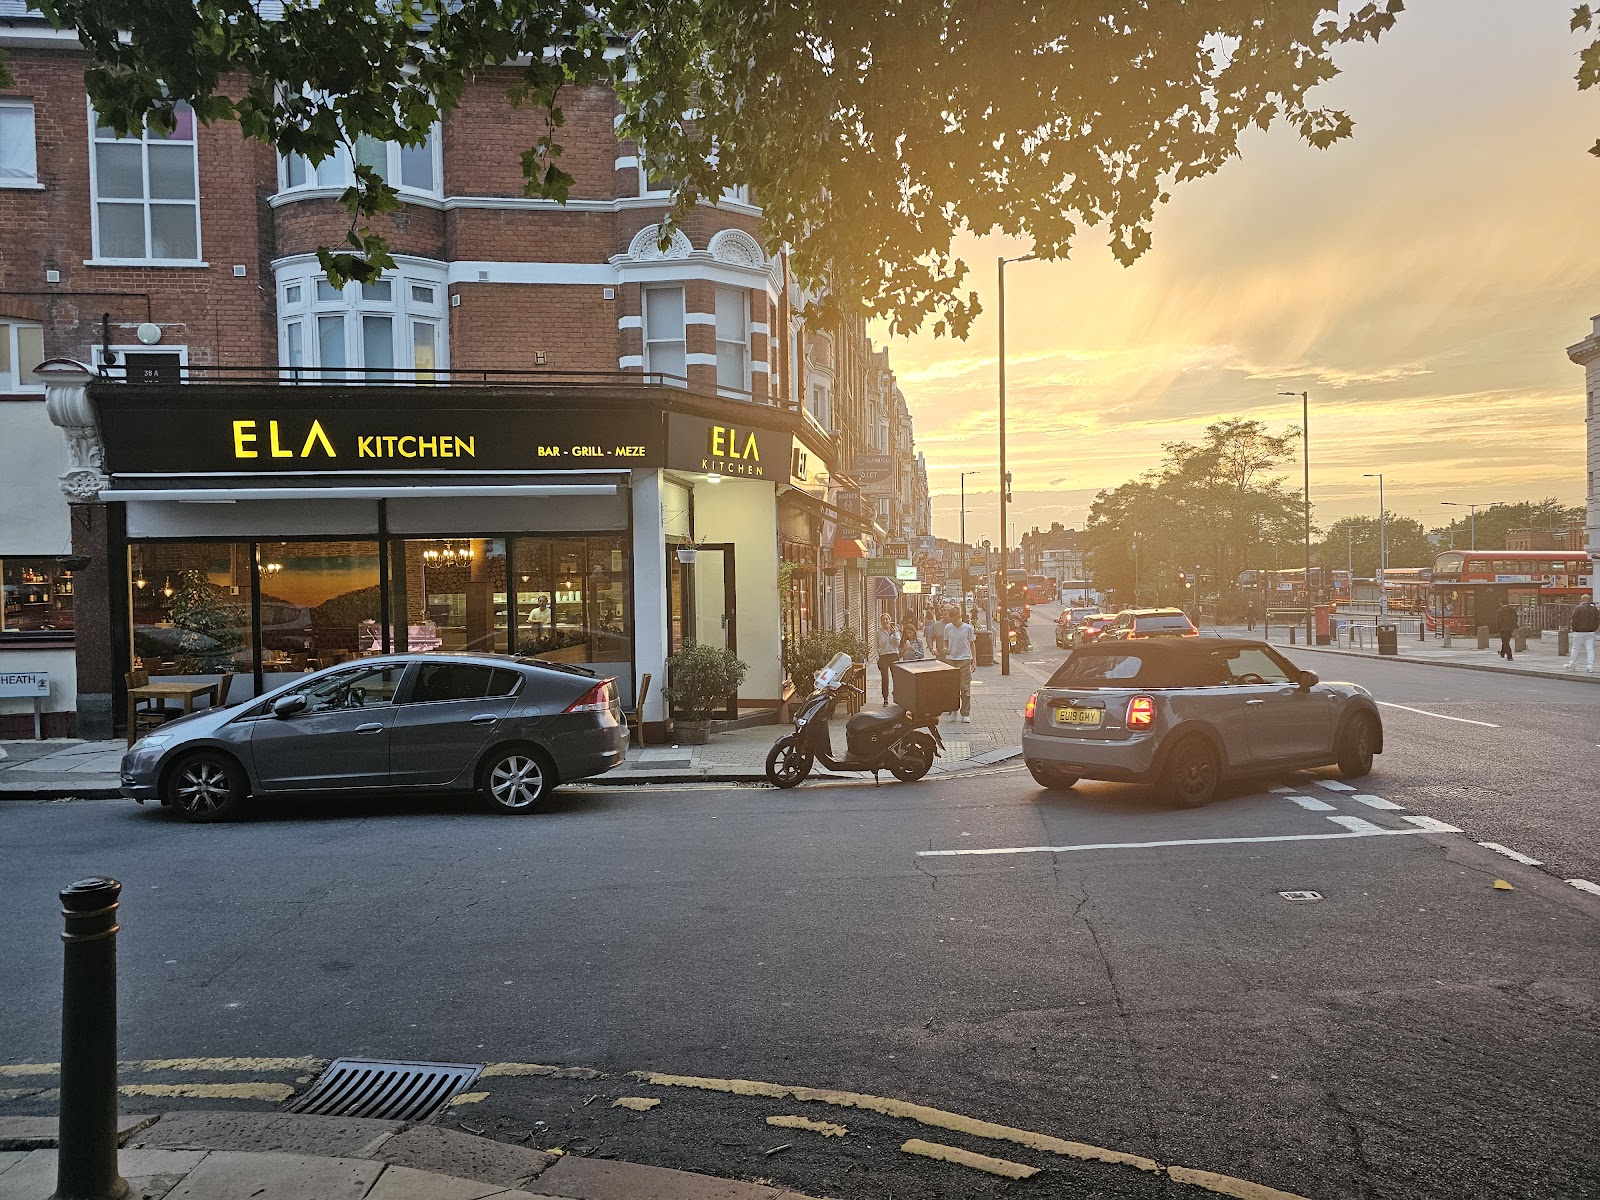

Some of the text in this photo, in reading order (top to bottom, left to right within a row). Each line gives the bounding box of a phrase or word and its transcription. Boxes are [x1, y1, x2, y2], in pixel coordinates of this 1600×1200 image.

[232, 420, 476, 458] ELA KITCHEN
[712, 425, 760, 462] ELA
[537, 446, 561, 457] BAR
[571, 446, 605, 457] GRILL
[615, 446, 646, 457] MEZE
[702, 458, 763, 476] KITCHEN
[0, 675, 36, 684] HEATH
